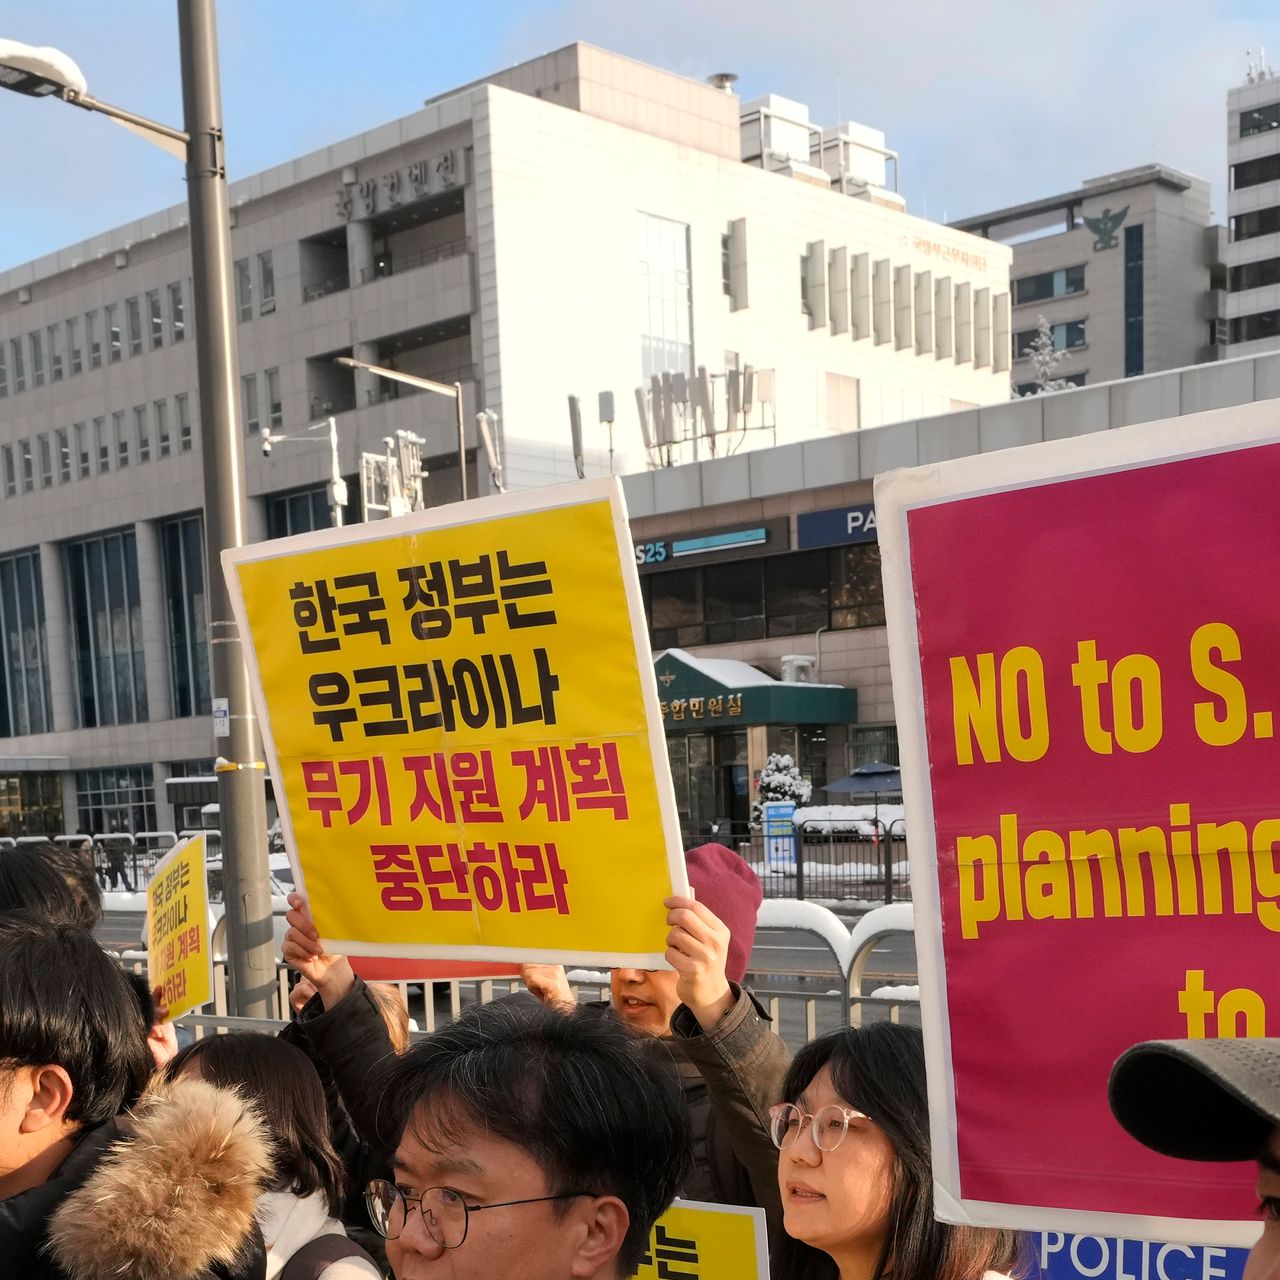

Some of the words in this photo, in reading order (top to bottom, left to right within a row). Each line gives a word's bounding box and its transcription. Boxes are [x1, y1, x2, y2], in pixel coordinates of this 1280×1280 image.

[288, 570, 392, 655] 한국
[397, 550, 558, 641] 정부는
[308, 648, 560, 743] 우크라이나
[949, 645, 1050, 766] NO
[1072, 639, 1162, 754] to
[301, 756, 393, 829] 무기
[402, 749, 505, 824] 지원
[510, 742, 630, 823] 계획
[165, 860, 190, 900] 정부는
[369, 841, 571, 916] 중단하라
[178, 924, 201, 962] 계획
